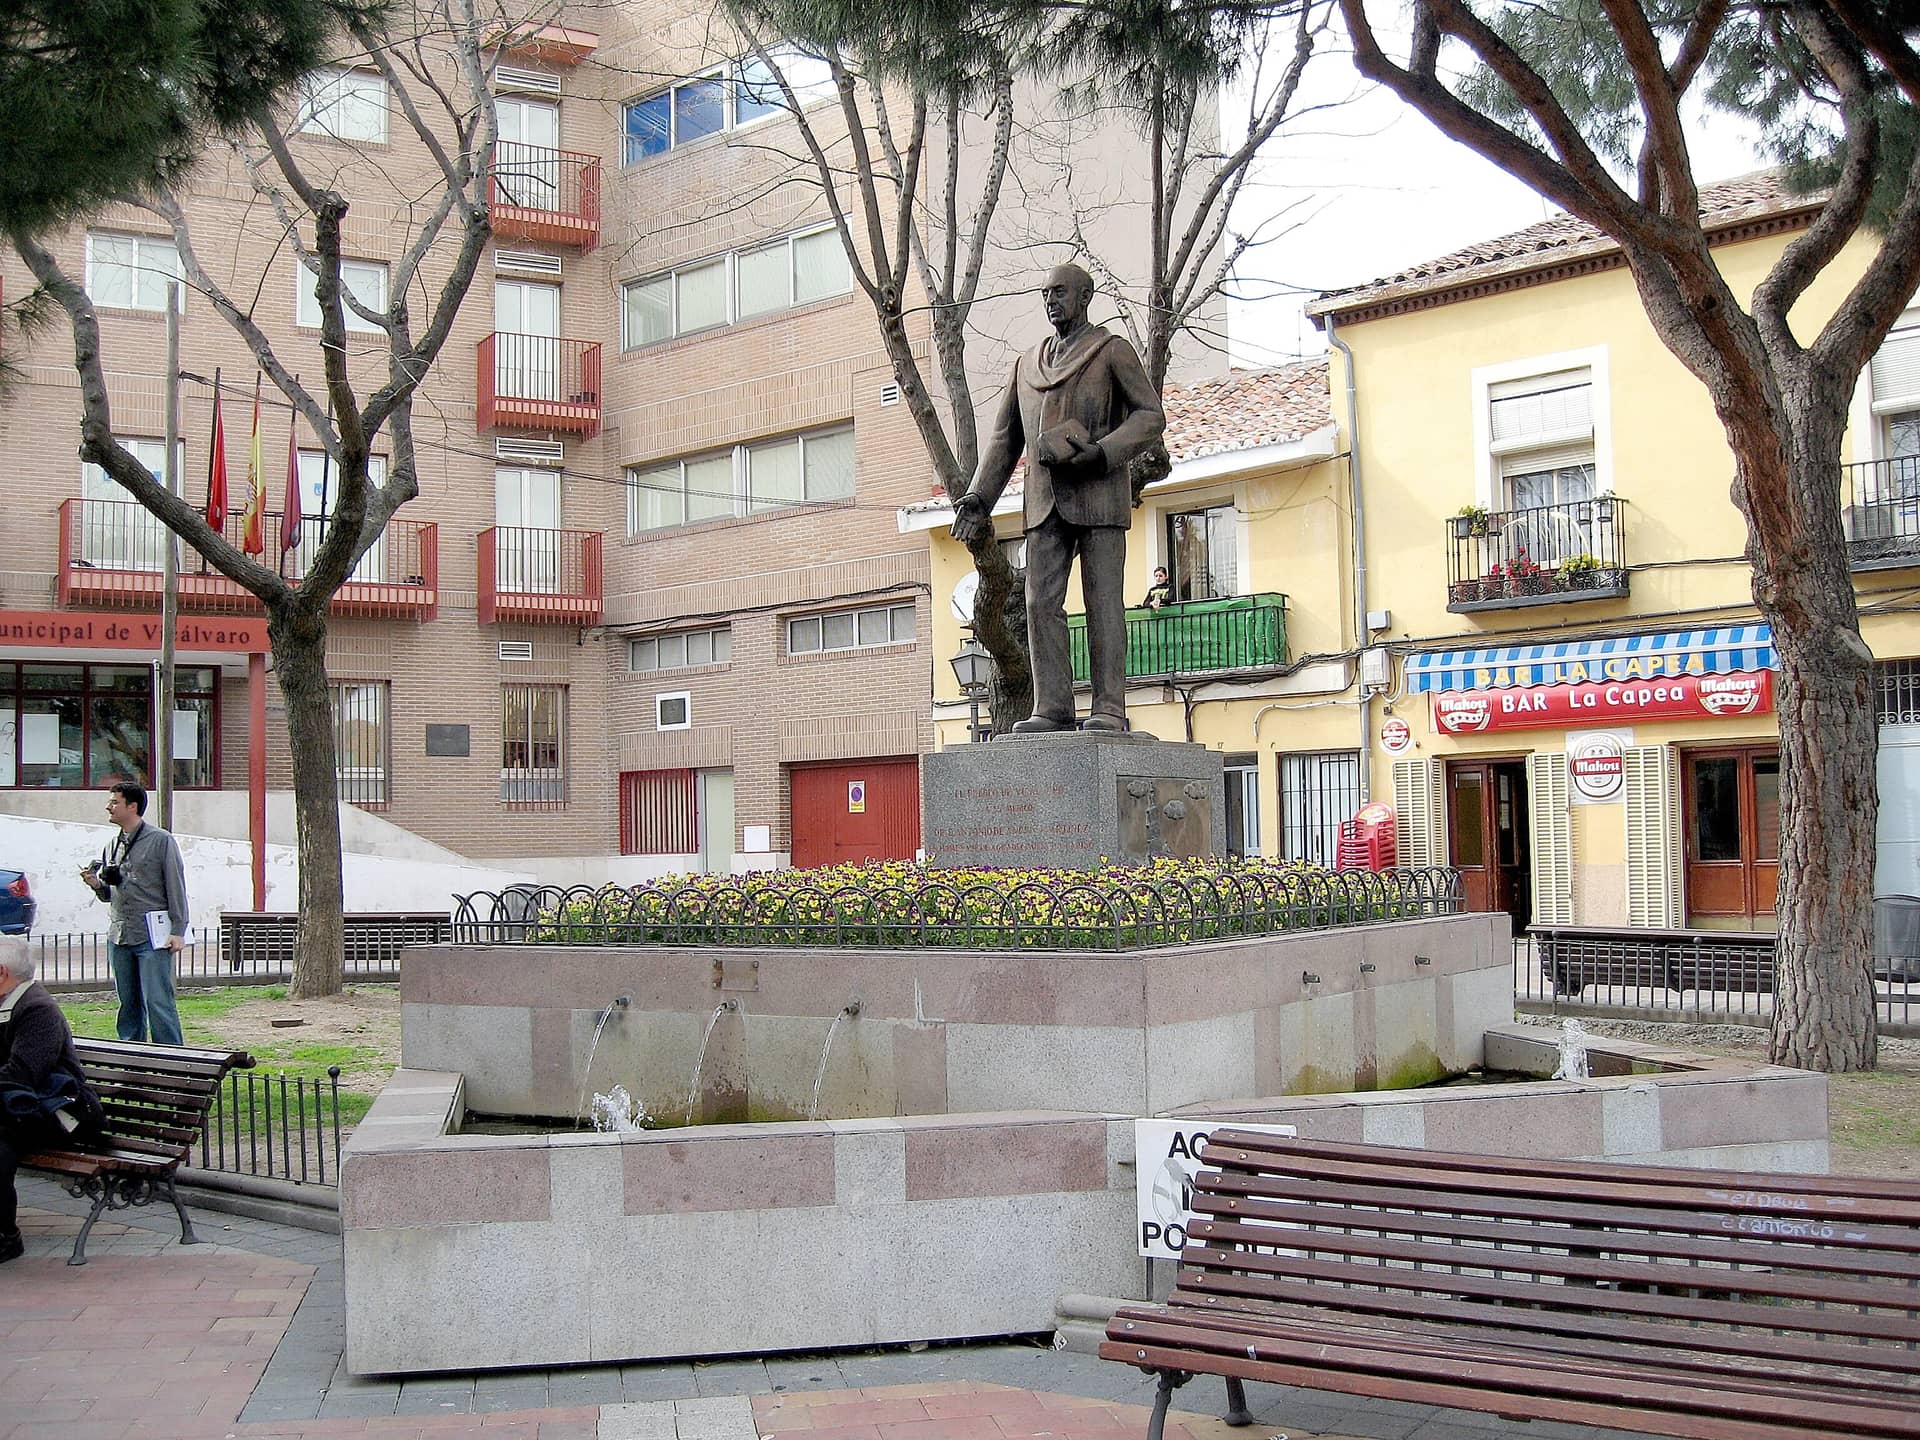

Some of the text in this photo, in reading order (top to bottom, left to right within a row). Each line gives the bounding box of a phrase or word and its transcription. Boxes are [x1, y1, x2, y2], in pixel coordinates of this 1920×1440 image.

[105, 623, 130, 641] de
[1476, 655, 1703, 685] BAR LA CAPEA
[1440, 678, 1757, 713] Mahou BAR La Capea Mahou
[1576, 760, 1620, 773] Mahou
